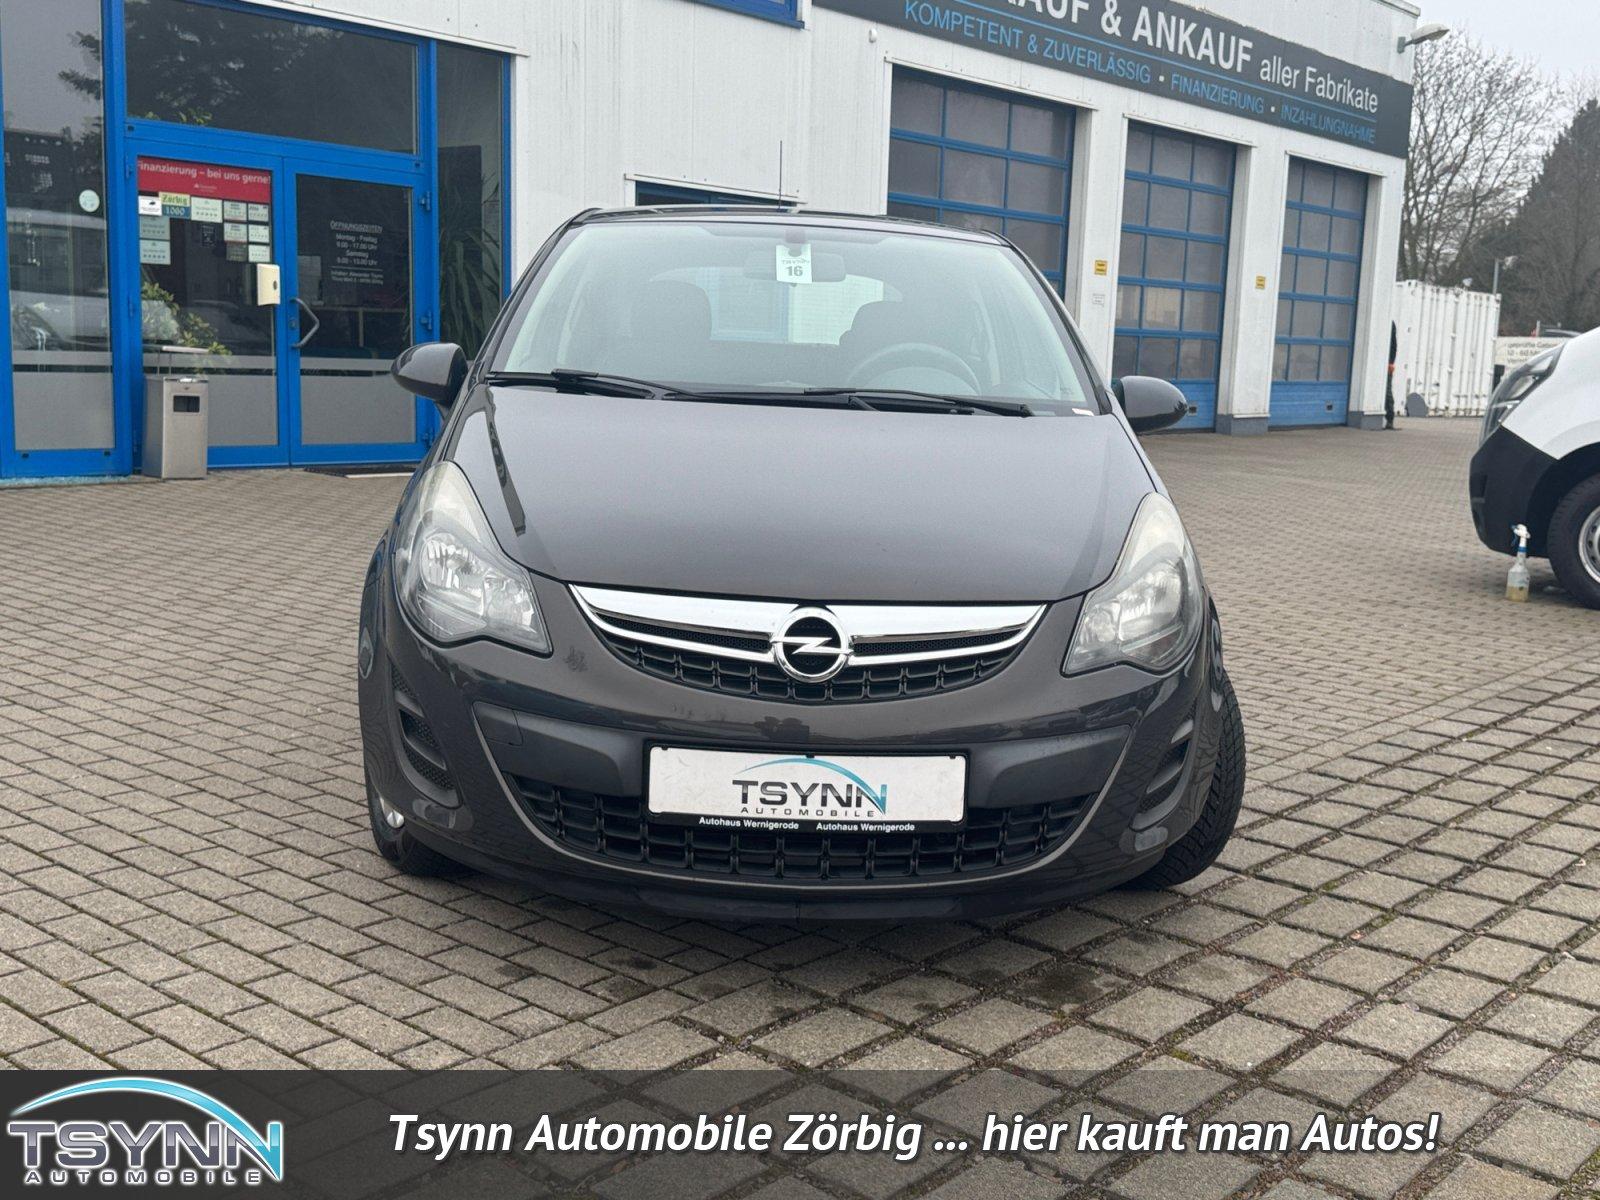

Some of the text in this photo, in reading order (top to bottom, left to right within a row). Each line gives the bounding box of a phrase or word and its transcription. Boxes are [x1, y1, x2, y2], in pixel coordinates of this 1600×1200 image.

[1101, 0, 1122, 37] &
[1132, 6, 1253, 73] ANKAUF
[1260, 56, 1300, 89] aller
[1305, 66, 1378, 114] Fabrikate
[904, 0, 1377, 145] KOMPETENT & ZUVERLÄSSIG FINANZIERUNG INZAHLUNGNAHME
[207, 168, 222, 179] bei
[223, 172, 241, 182] uns
[786, 265, 803, 277] 16
[732, 779, 888, 814] TSYNN
[741, 806, 875, 818] AUTOMOBILE
[699, 816, 915, 833] Autohaus Wernigerode Autohaus Wernigerode
